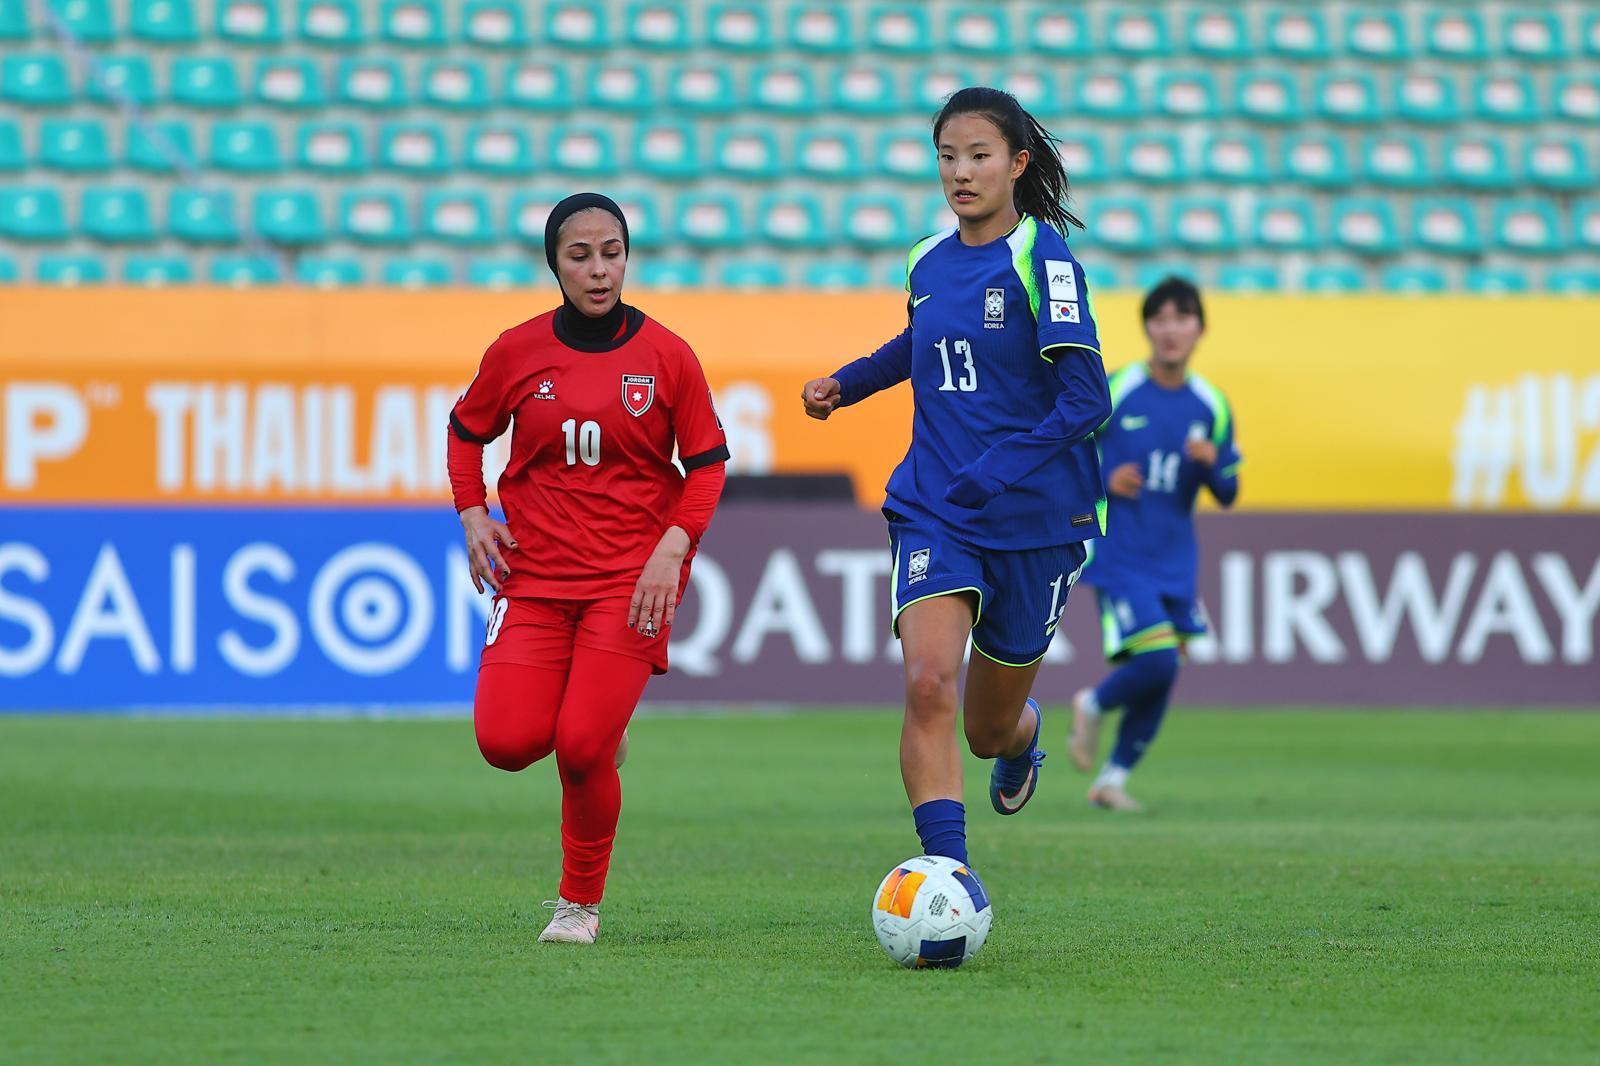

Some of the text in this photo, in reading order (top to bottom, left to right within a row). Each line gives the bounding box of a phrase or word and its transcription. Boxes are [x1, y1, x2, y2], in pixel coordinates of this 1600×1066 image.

[1051, 274, 1072, 285] AFC
[934, 336, 977, 392] 13
[626, 376, 651, 384] JORDAN
[533, 392, 556, 400] KELME
[561, 418, 601, 467] 10
[908, 574, 928, 586] KOREA
